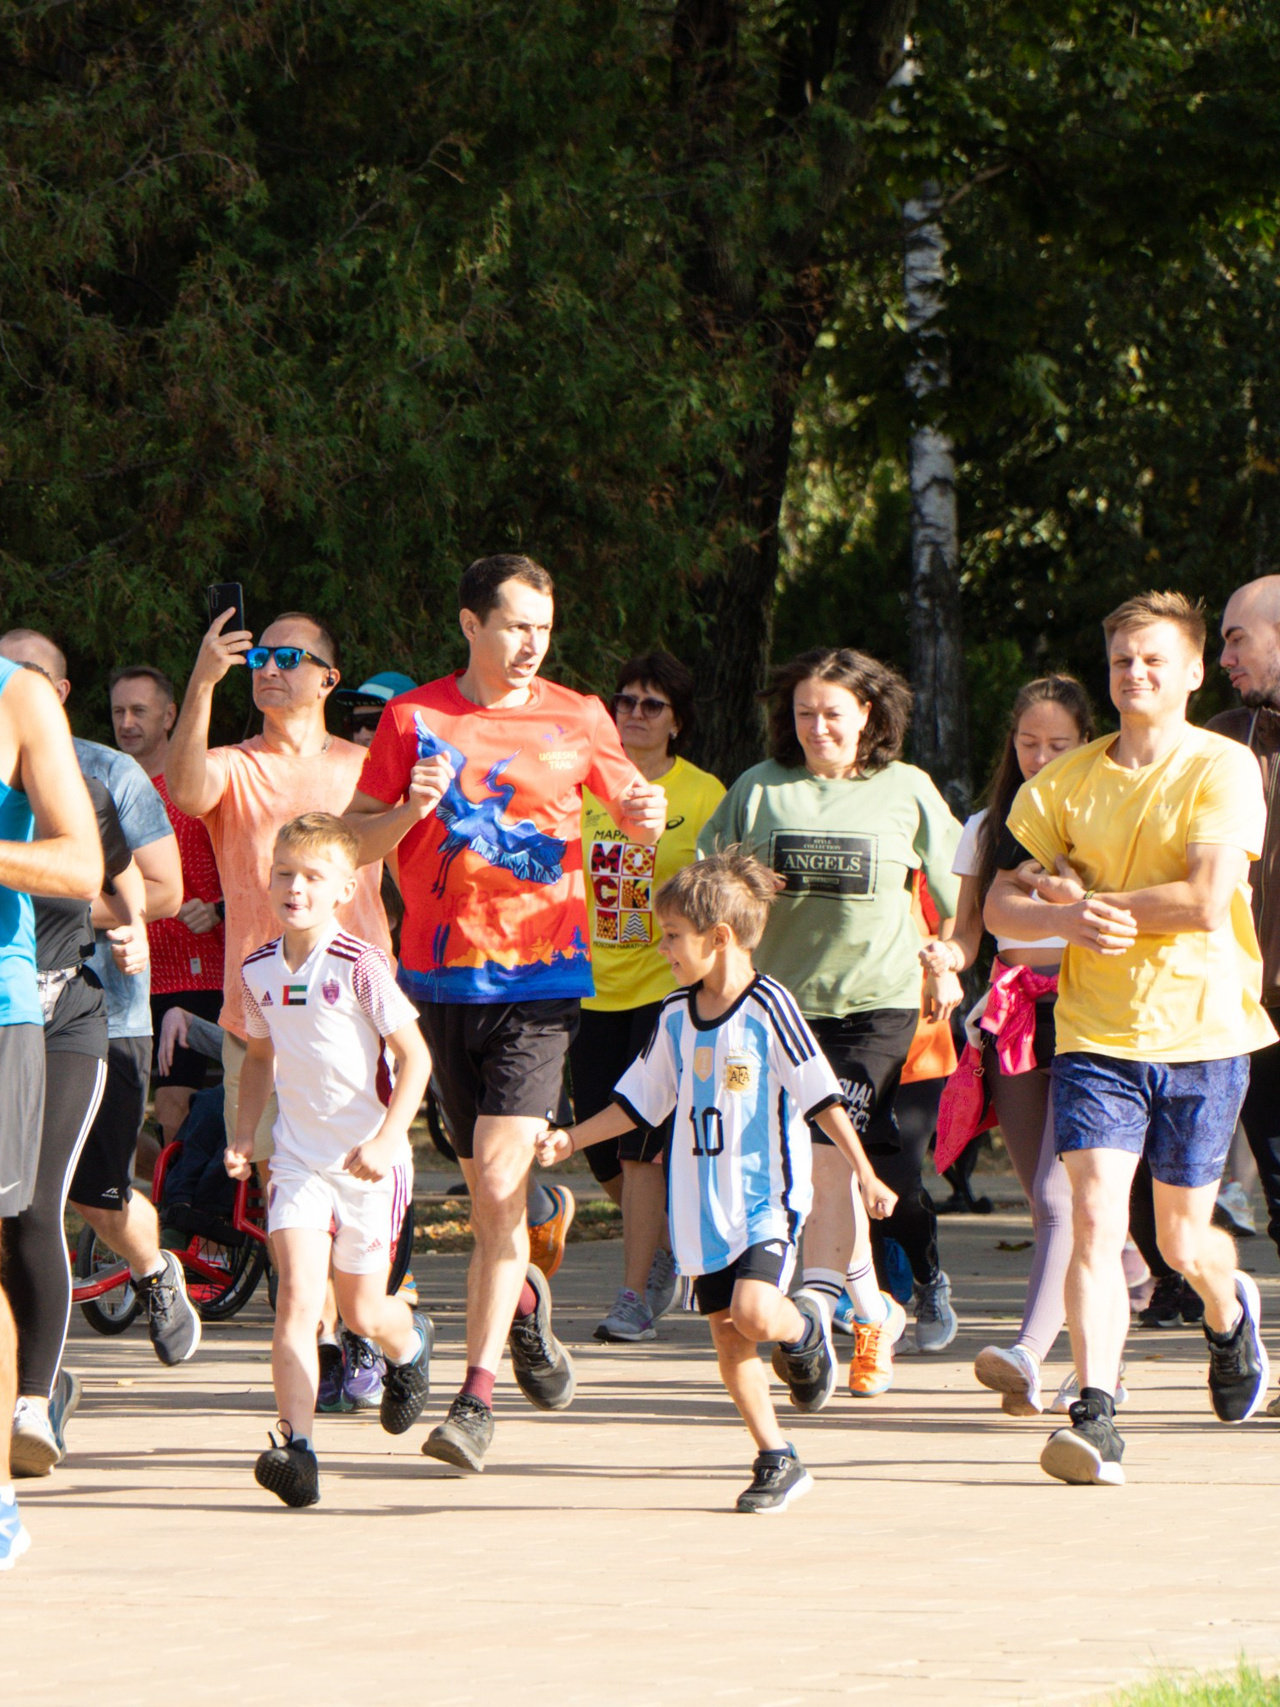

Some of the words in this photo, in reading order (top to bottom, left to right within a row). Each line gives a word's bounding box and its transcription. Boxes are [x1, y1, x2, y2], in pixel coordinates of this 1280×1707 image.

[784, 854, 861, 873] ANGELS
[729, 1066, 751, 1085] AFA
[689, 1106, 724, 1157] 10
